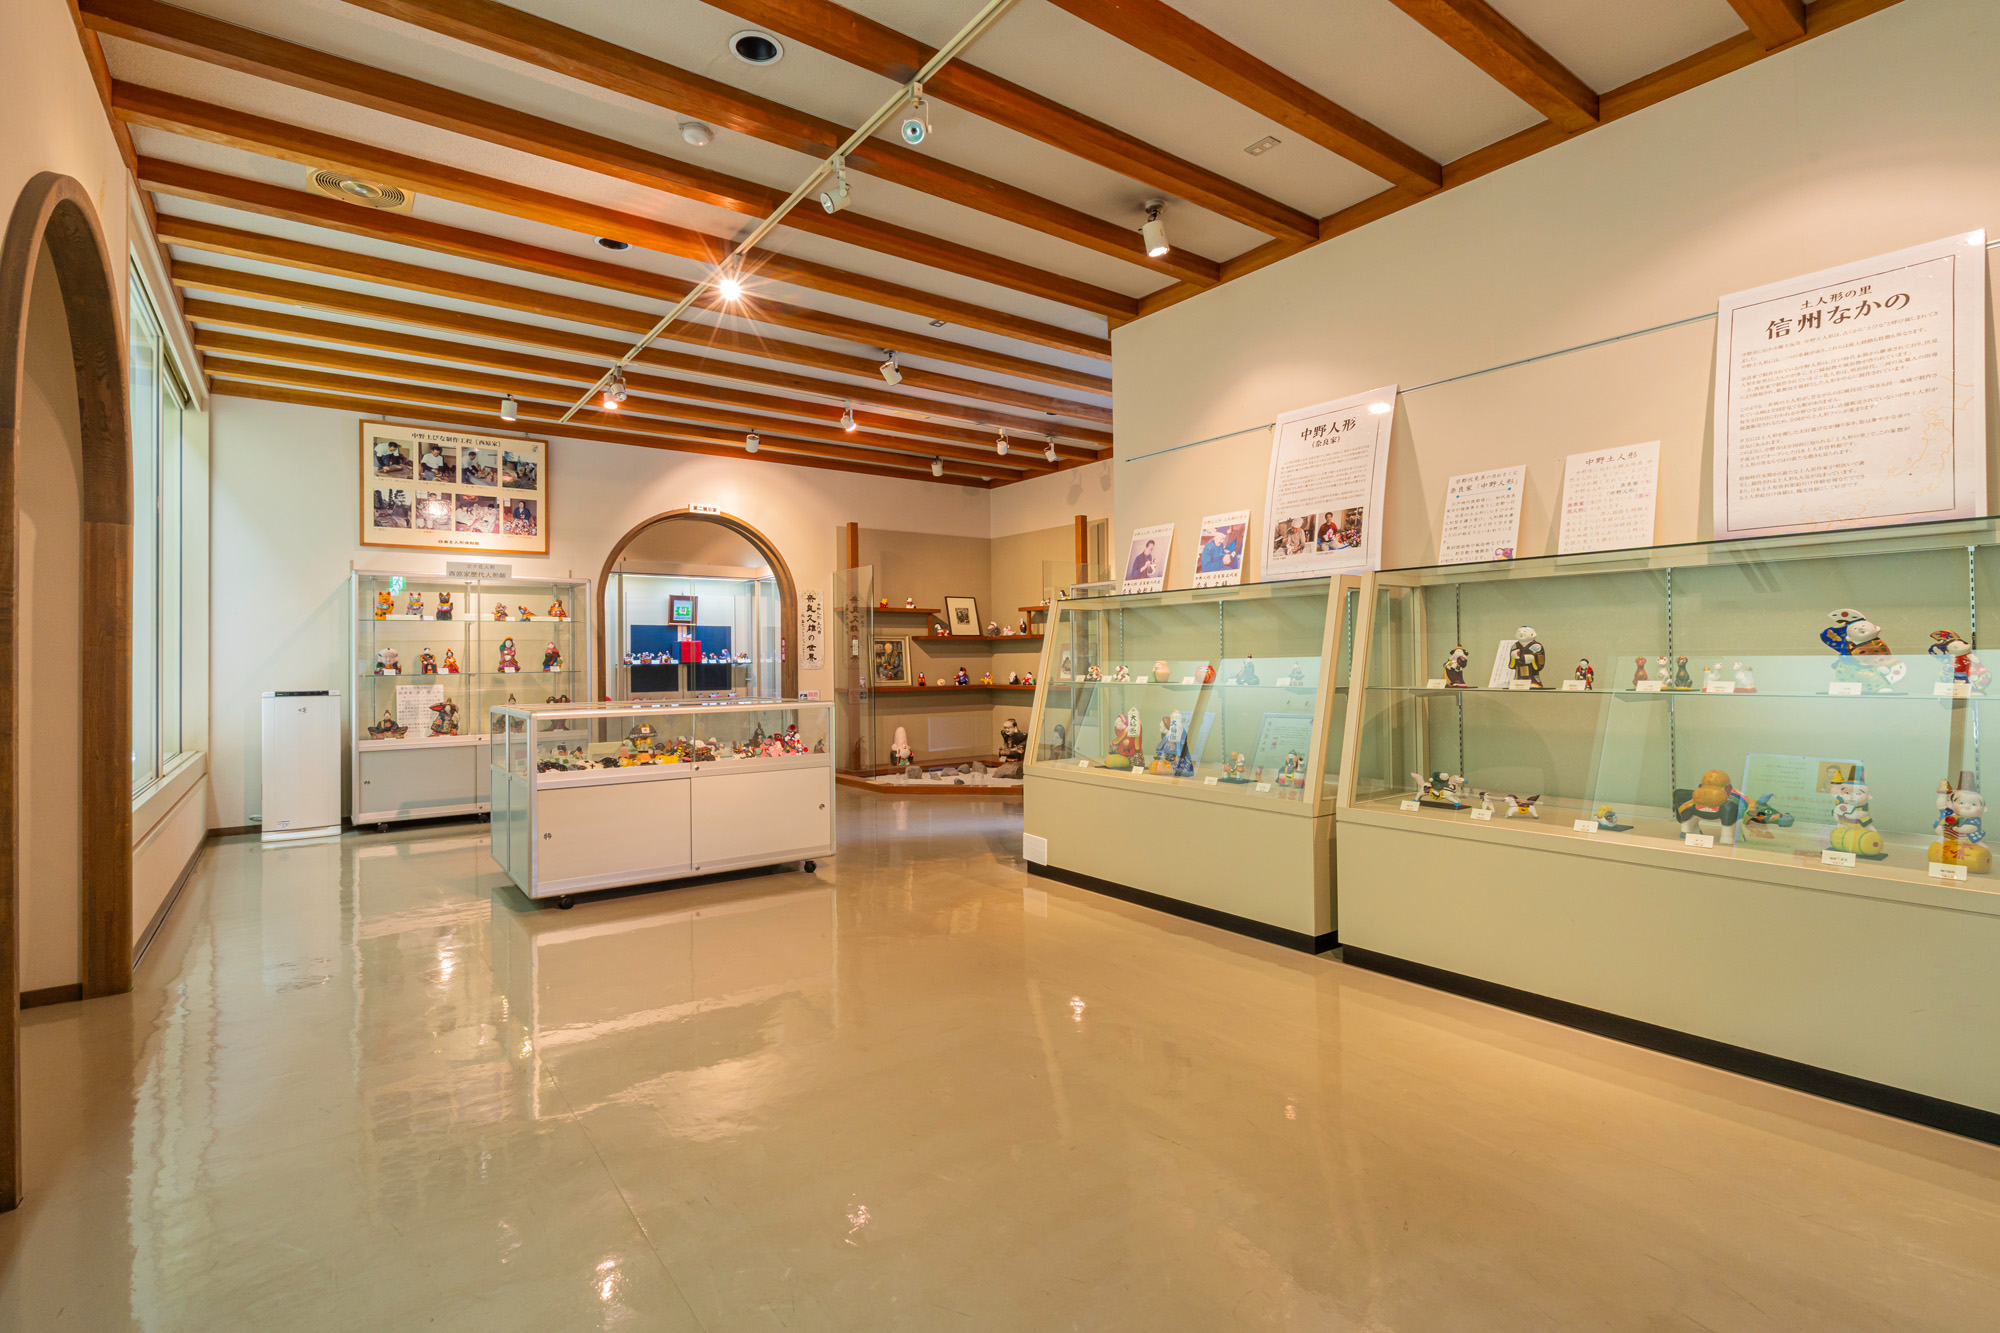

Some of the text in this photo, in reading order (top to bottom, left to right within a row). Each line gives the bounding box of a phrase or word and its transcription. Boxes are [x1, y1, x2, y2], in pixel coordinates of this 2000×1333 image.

[1801, 285, 1873, 310] 土人形の里
[1765, 292, 1910, 340] 信州なかの
[1300, 417, 1357, 441] 中野人形
[1585, 450, 1637, 466] 中野土人形
[806, 594, 817, 662] 奈良久雄の世界
